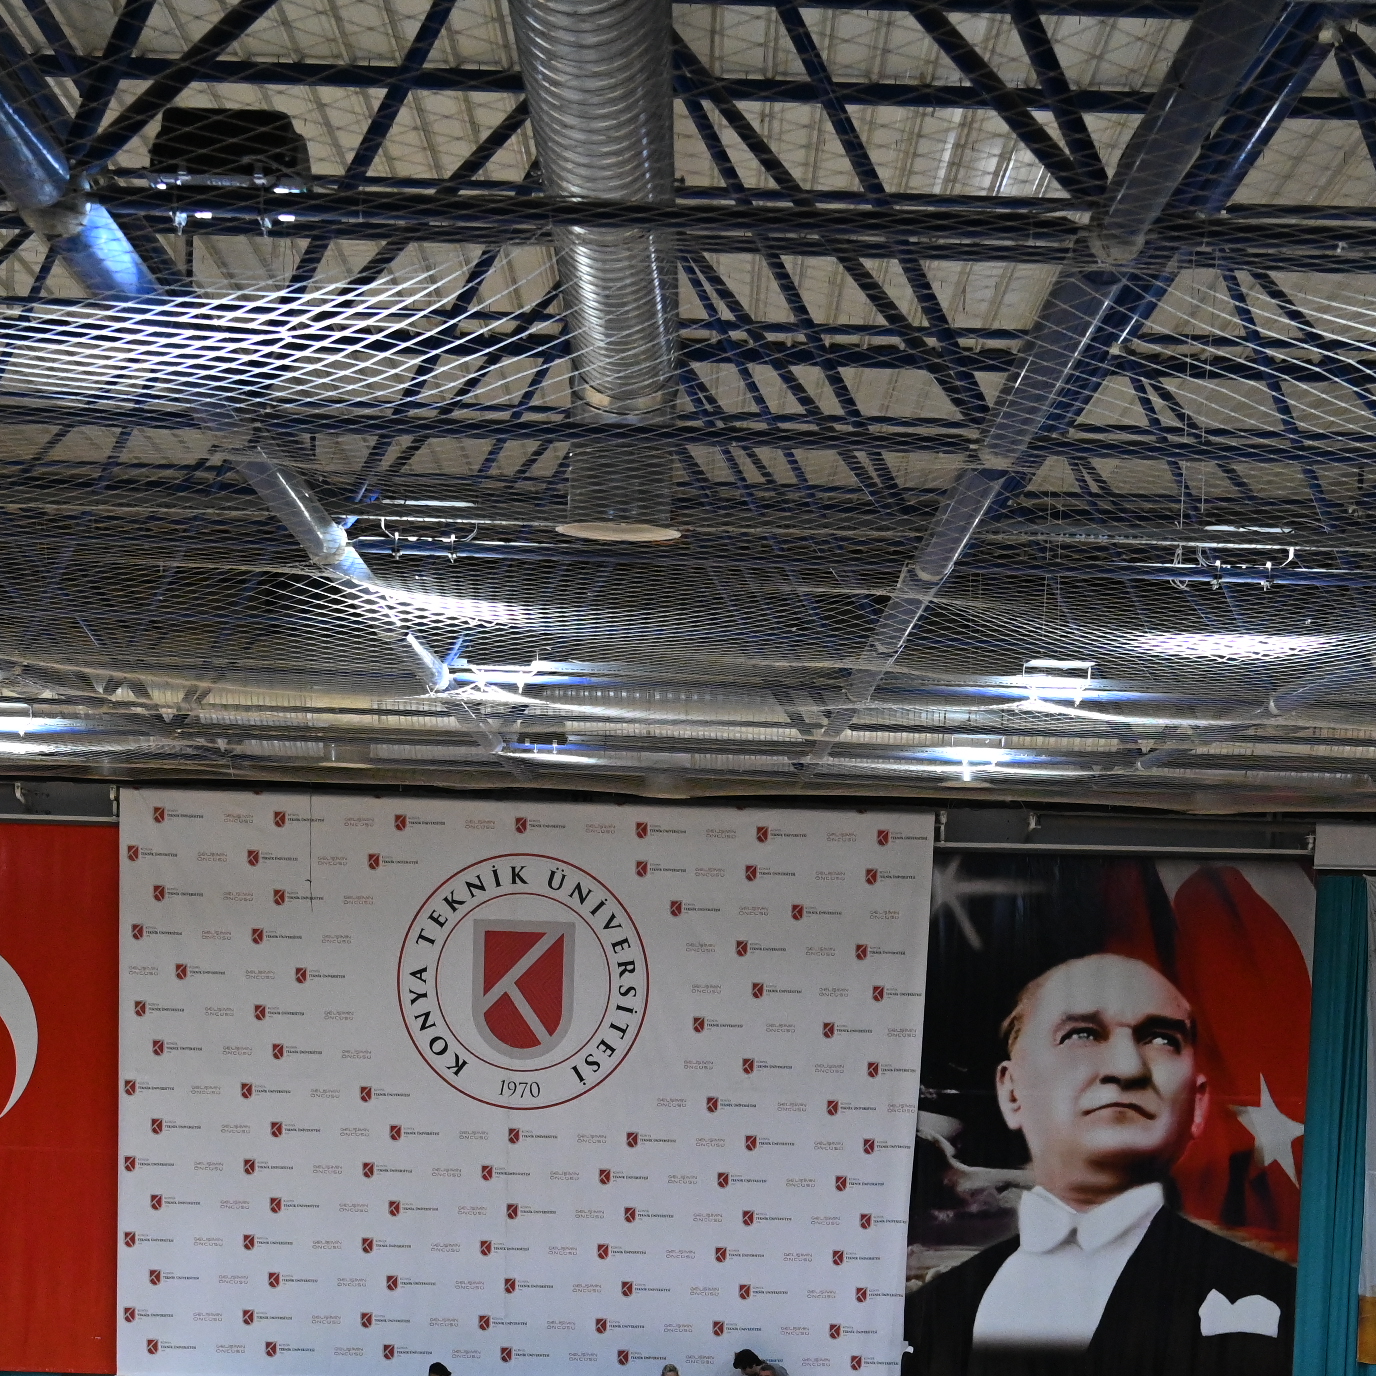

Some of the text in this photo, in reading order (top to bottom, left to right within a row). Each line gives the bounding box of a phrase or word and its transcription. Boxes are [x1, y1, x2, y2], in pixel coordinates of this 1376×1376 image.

[409, 864, 638, 1086] KONYA TEKNİK ÜNİVERSİTESİ
[498, 1079, 541, 1099] 1970
